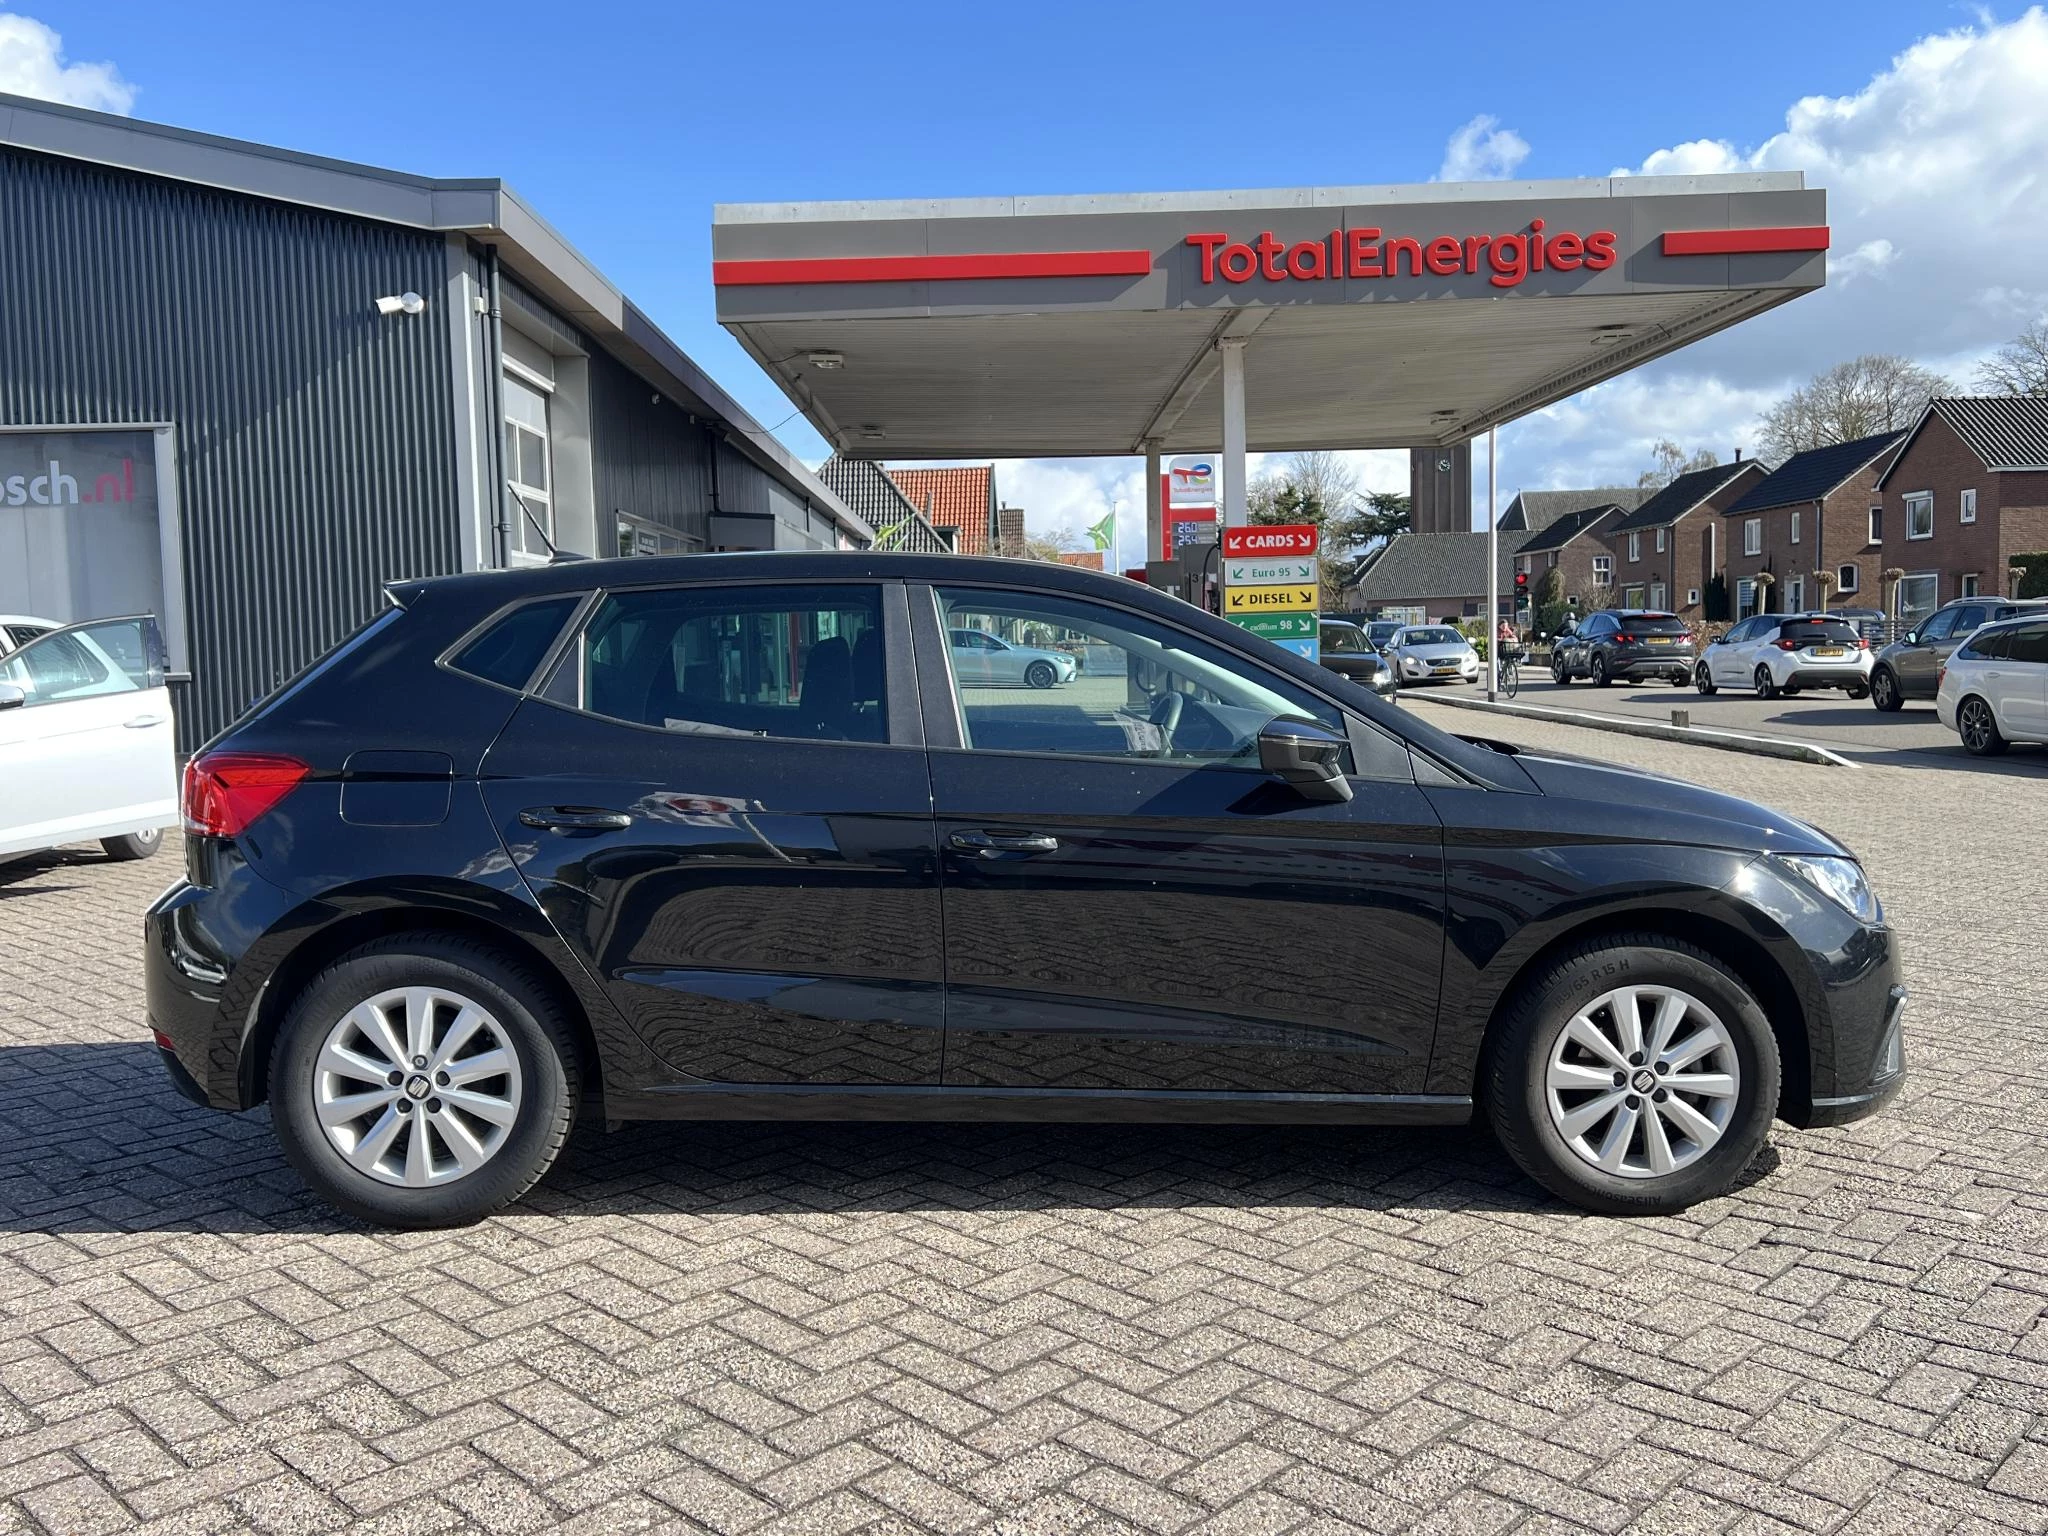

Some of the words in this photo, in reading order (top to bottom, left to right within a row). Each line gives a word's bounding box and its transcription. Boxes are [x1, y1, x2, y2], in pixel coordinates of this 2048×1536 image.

[1186, 217, 1617, 287] TotalEnergies
[0, 458, 135, 506] sch.nl
[1246, 534, 1294, 548] CARDS
[1252, 568, 1275, 578] Euro
[1279, 567, 1290, 577] 95
[1250, 593, 1293, 605] DIESEL
[1280, 620, 1293, 630] 98
[1602, 962, 1616, 976] 15
[1619, 958, 1630, 971] H
